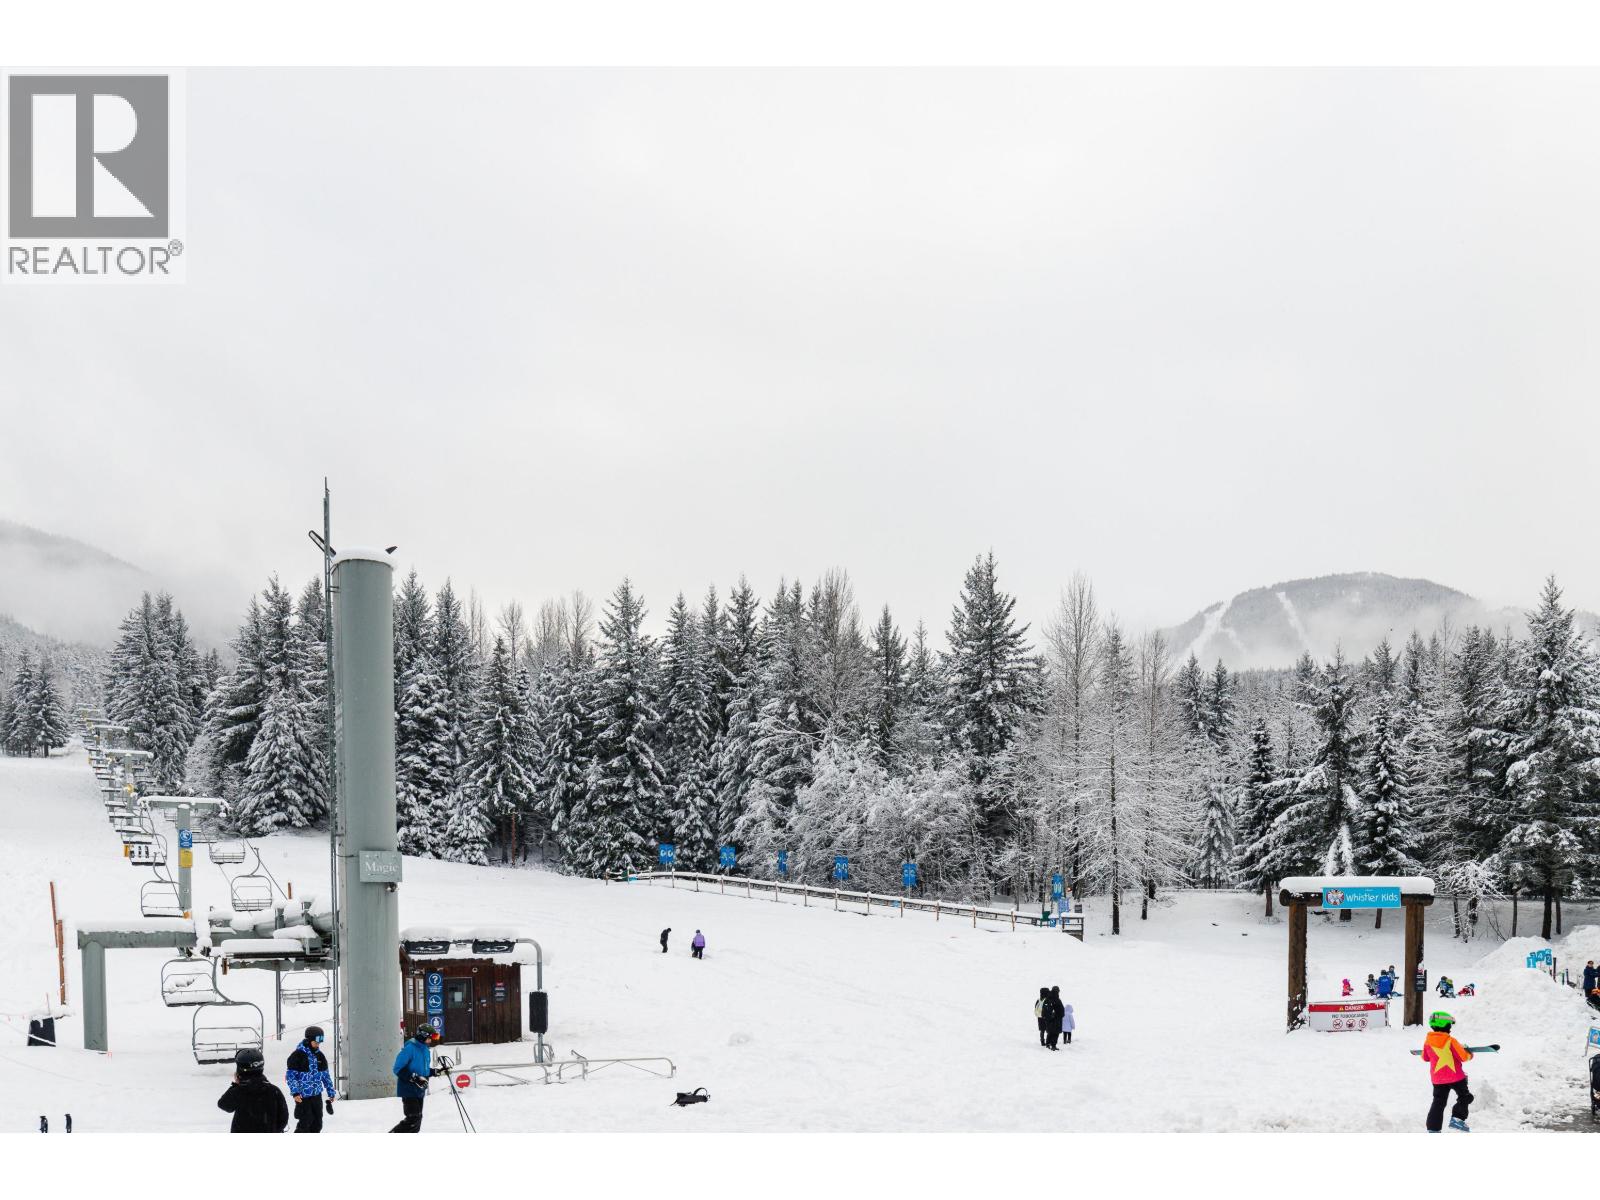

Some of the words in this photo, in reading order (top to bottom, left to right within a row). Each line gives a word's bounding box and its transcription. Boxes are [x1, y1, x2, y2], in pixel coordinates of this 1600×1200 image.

[365, 861, 399, 874] Magic
[1346, 892, 1379, 902] Whistler
[1381, 892, 1399, 902] Kids
